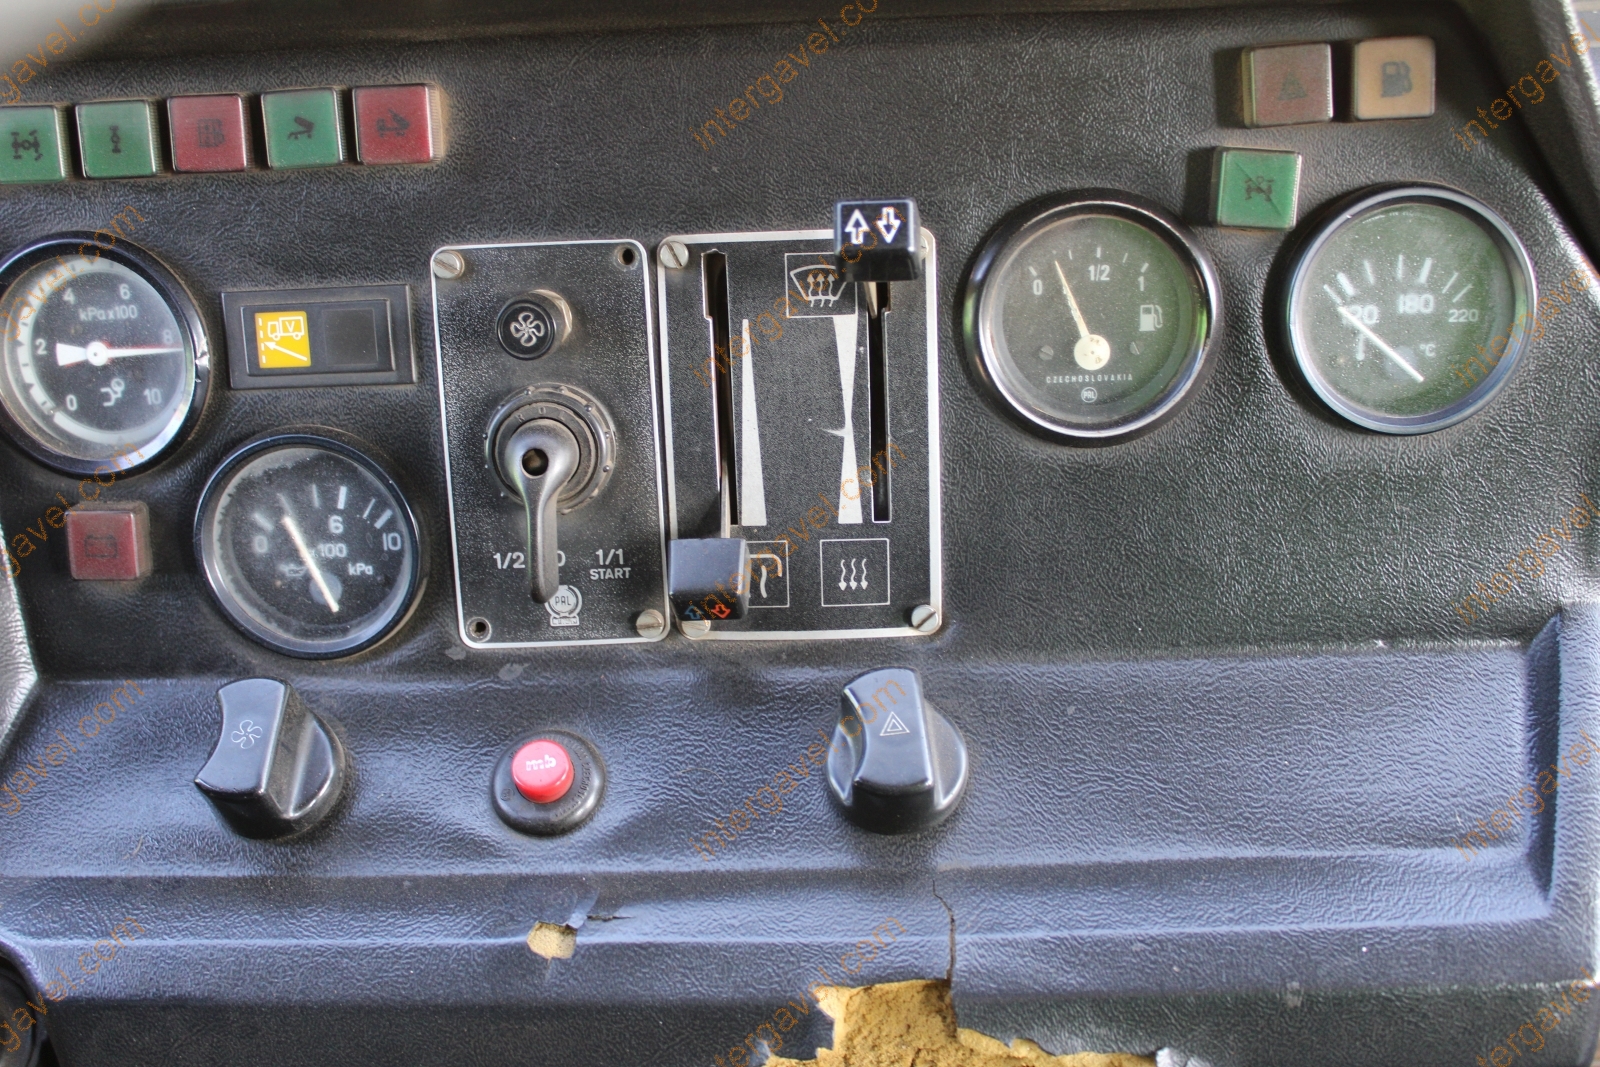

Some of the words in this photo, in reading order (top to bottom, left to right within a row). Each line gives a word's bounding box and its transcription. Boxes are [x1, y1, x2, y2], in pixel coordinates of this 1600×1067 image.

[1088, 264, 1110, 281] 1/2
[1032, 279, 1043, 295] 0
[1138, 275, 1145, 291] 1
[62, 287, 76, 304] 4
[119, 284, 131, 300] 6
[1448, 308, 1479, 323] 220
[162, 329, 174, 345] 8
[35, 338, 47, 356] 2
[1046, 373, 1133, 384] CZECHOSLOVAKIA
[65, 394, 78, 412] 0
[143, 387, 161, 405] 10
[328, 515, 344, 534] 6
[254, 535, 268, 554] 0
[382, 532, 401, 551] 10
[493, 551, 526, 569] 1/2
[595, 548, 624, 565] 1/1
[347, 561, 374, 576] kPa
[589, 567, 632, 581] START
[554, 595, 572, 606] PAL
